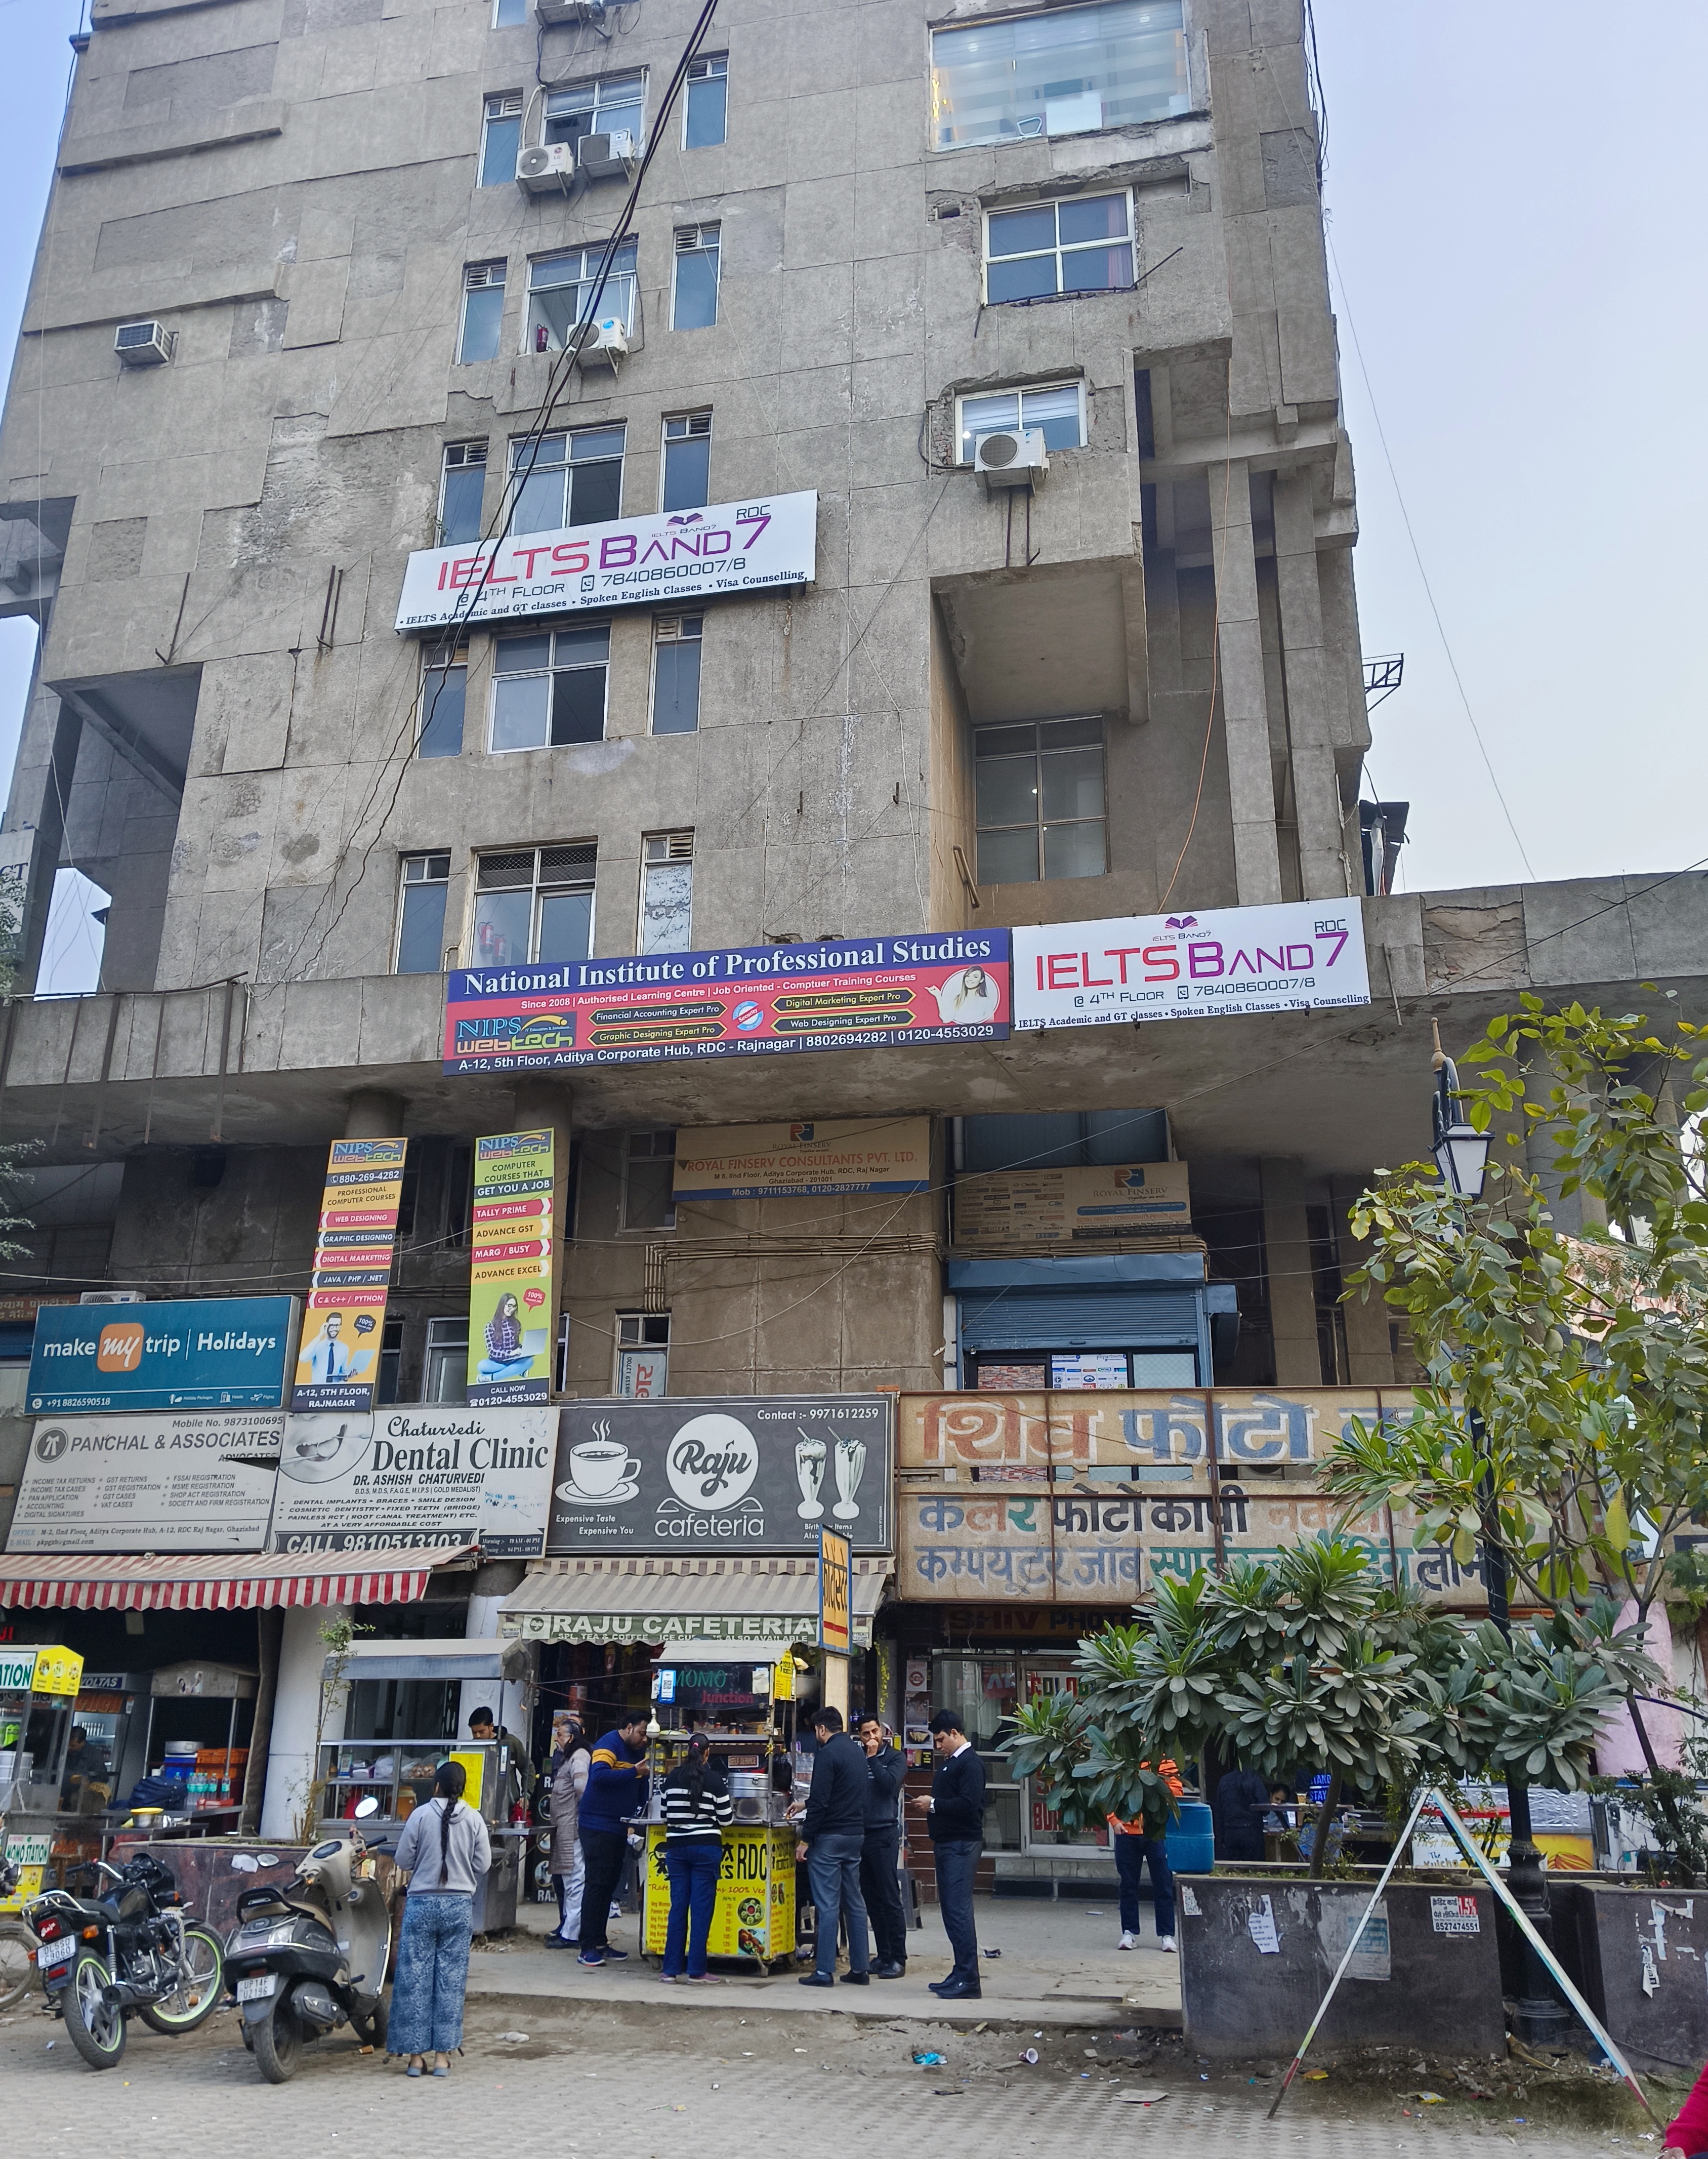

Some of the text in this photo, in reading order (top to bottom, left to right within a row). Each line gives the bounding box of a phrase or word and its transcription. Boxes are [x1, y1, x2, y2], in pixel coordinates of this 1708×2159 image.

[736, 505, 770, 519] RDC
[438, 541, 589, 590] IELTS
[601, 557, 746, 587] 7840860007/8
[580, 571, 805, 607] Spoken English Classes Visa Counselling
[1315, 919, 1347, 932] RDC
[464, 937, 991, 995] National Institute of Professional Studies
[1036, 944, 1181, 991] IELTS
[521, 1000, 547, 1009] Since
[549, 998, 570, 1007] 2008
[577, 993, 628, 1005] Authorised
[631, 990, 672, 1002] Learning
[674, 988, 704, 998] Centre
[713, 985, 730, 996] Job
[733, 982, 774, 993] Oriented
[833, 976, 872, 988] Training
[876, 973, 916, 984] Courses
[1193, 977, 1316, 997] 7840860007/8
[786, 992, 900, 1008] Digital Marketing Expert Pro
[1049, 993, 1369, 1026] Academic Spoken English Counselling
[457, 1017, 522, 1039] NIPS
[459, 1026, 993, 1071] A-12, 5th Floor, Aditya Corporate Hub, RDC Rajnagar 8802694282 0120-4553029
[492, 1161, 535, 1172] COMPUTER
[687, 1151, 918, 1172] ROYAL FINSERV CONSULTANTS PVT. LTD.
[856, 1166, 890, 1175] Raj Nagar
[339, 1170, 399, 1184] 880-269-4282
[484, 1169, 543, 1183] COURSES THAT
[338, 1187, 387, 1196] PROFESSIONAL
[478, 1179, 550, 1196] GET YOU A JOB
[732, 1188, 751, 1197] Mob
[812, 1183, 870, 1193] 0120-2827777
[327, 1194, 396, 1206] COMPUTER COURSES
[476, 1205, 527, 1218] TALLY PRIME
[476, 1227, 541, 1274] ADVANCE EXCEL
[43, 1331, 276, 1368] make my trip Holidays
[309, 1400, 355, 1408] RAJNAGAR
[479, 1393, 548, 1406] 0120-4553029
[172, 1416, 283, 1428] Mobile No. 9873100695
[757, 1408, 880, 1421] Contact 9971612259
[387, 1416, 485, 1438] Chaturvedi
[917, 1396, 1102, 1464] शिव
[1118, 1393, 1314, 1462] फोटो
[70, 1431, 280, 1452] PANCHAL & ASSOCIATES
[371, 1437, 549, 1472] Dental Clinic
[673, 1439, 753, 1497] Raju
[353, 1473, 485, 1486] DR. ASHISH CHATURVEDI
[556, 1514, 616, 1524] Expensive Taste
[918, 1495, 1042, 1533] कलर
[654, 1513, 764, 1537] cafeteria
[552, 1616, 633, 1633] RAJU
[642, 1616, 816, 1635] CAFETERIA
[80, 1678, 118, 1688] VOLTAS
[737, 1843, 768, 1881] RDC
